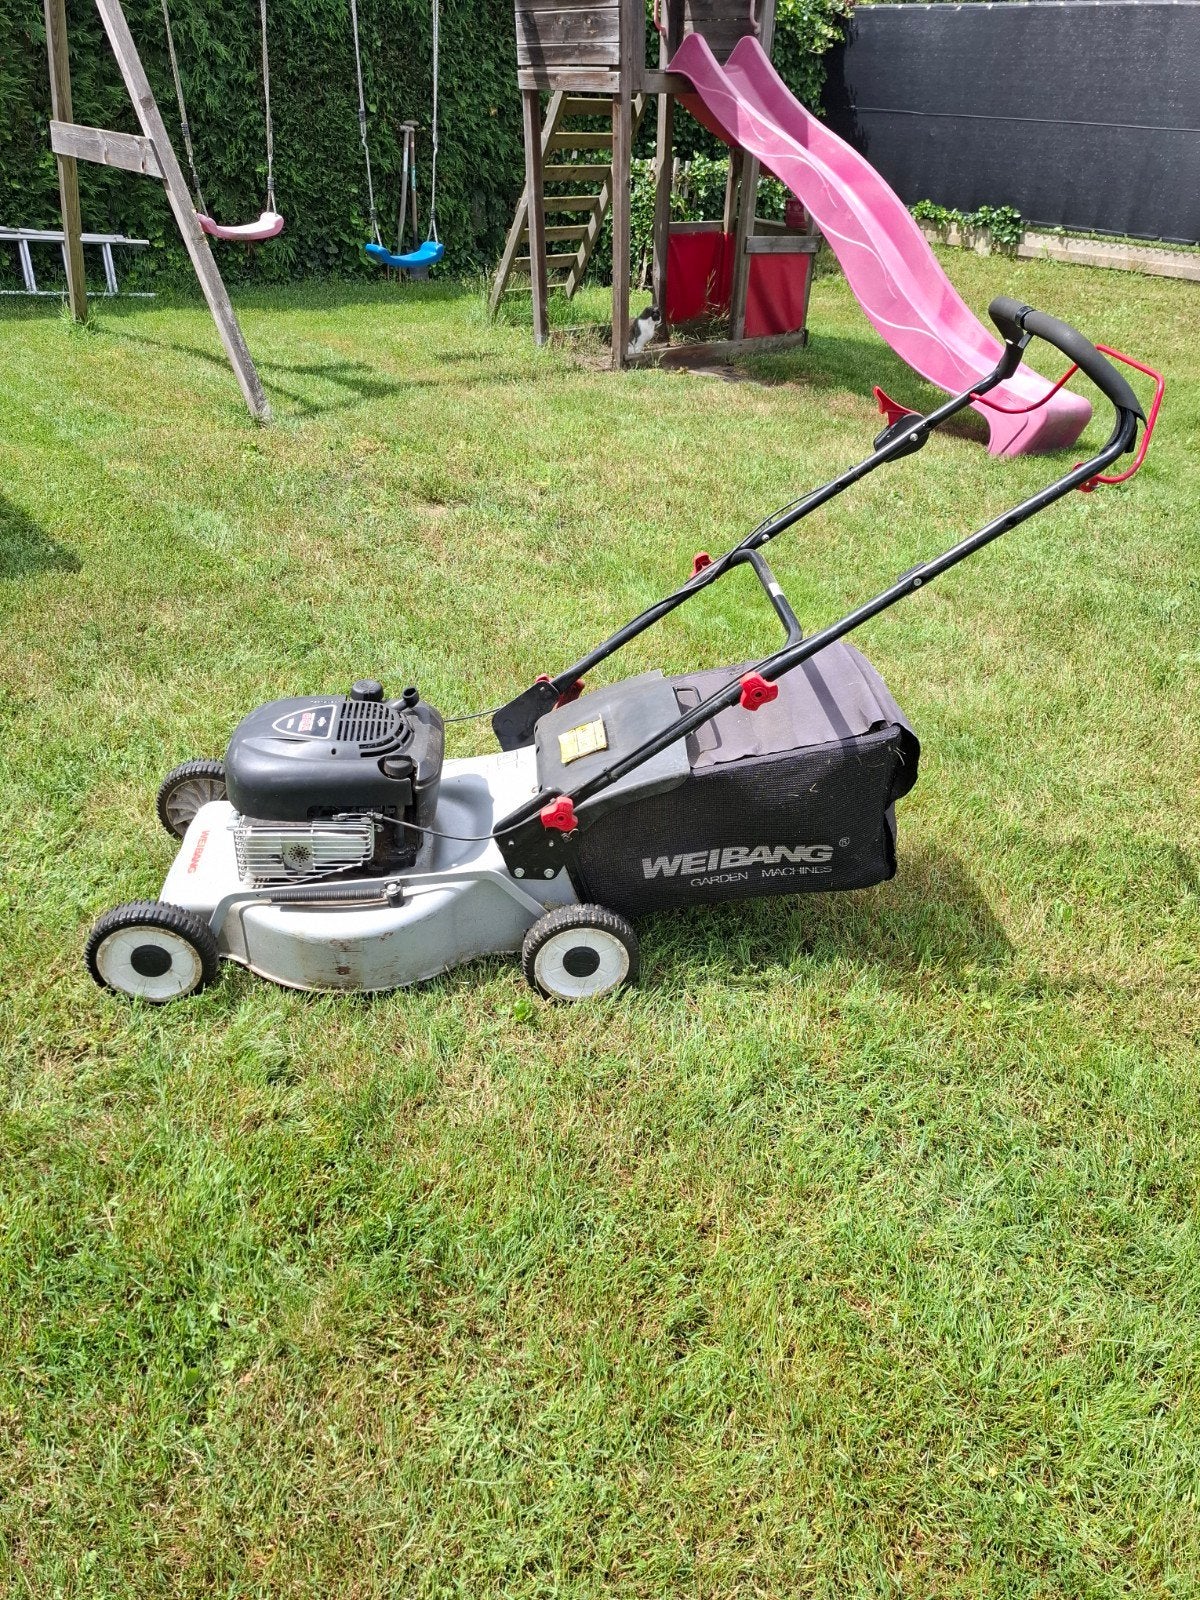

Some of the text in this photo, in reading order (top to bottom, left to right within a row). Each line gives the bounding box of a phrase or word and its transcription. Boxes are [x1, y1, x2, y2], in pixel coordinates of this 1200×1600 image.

[187, 830, 210, 873] WEIBANG
[641, 844, 834, 880] WEIBANG
[690, 865, 833, 887] GARDEN MACHINES
